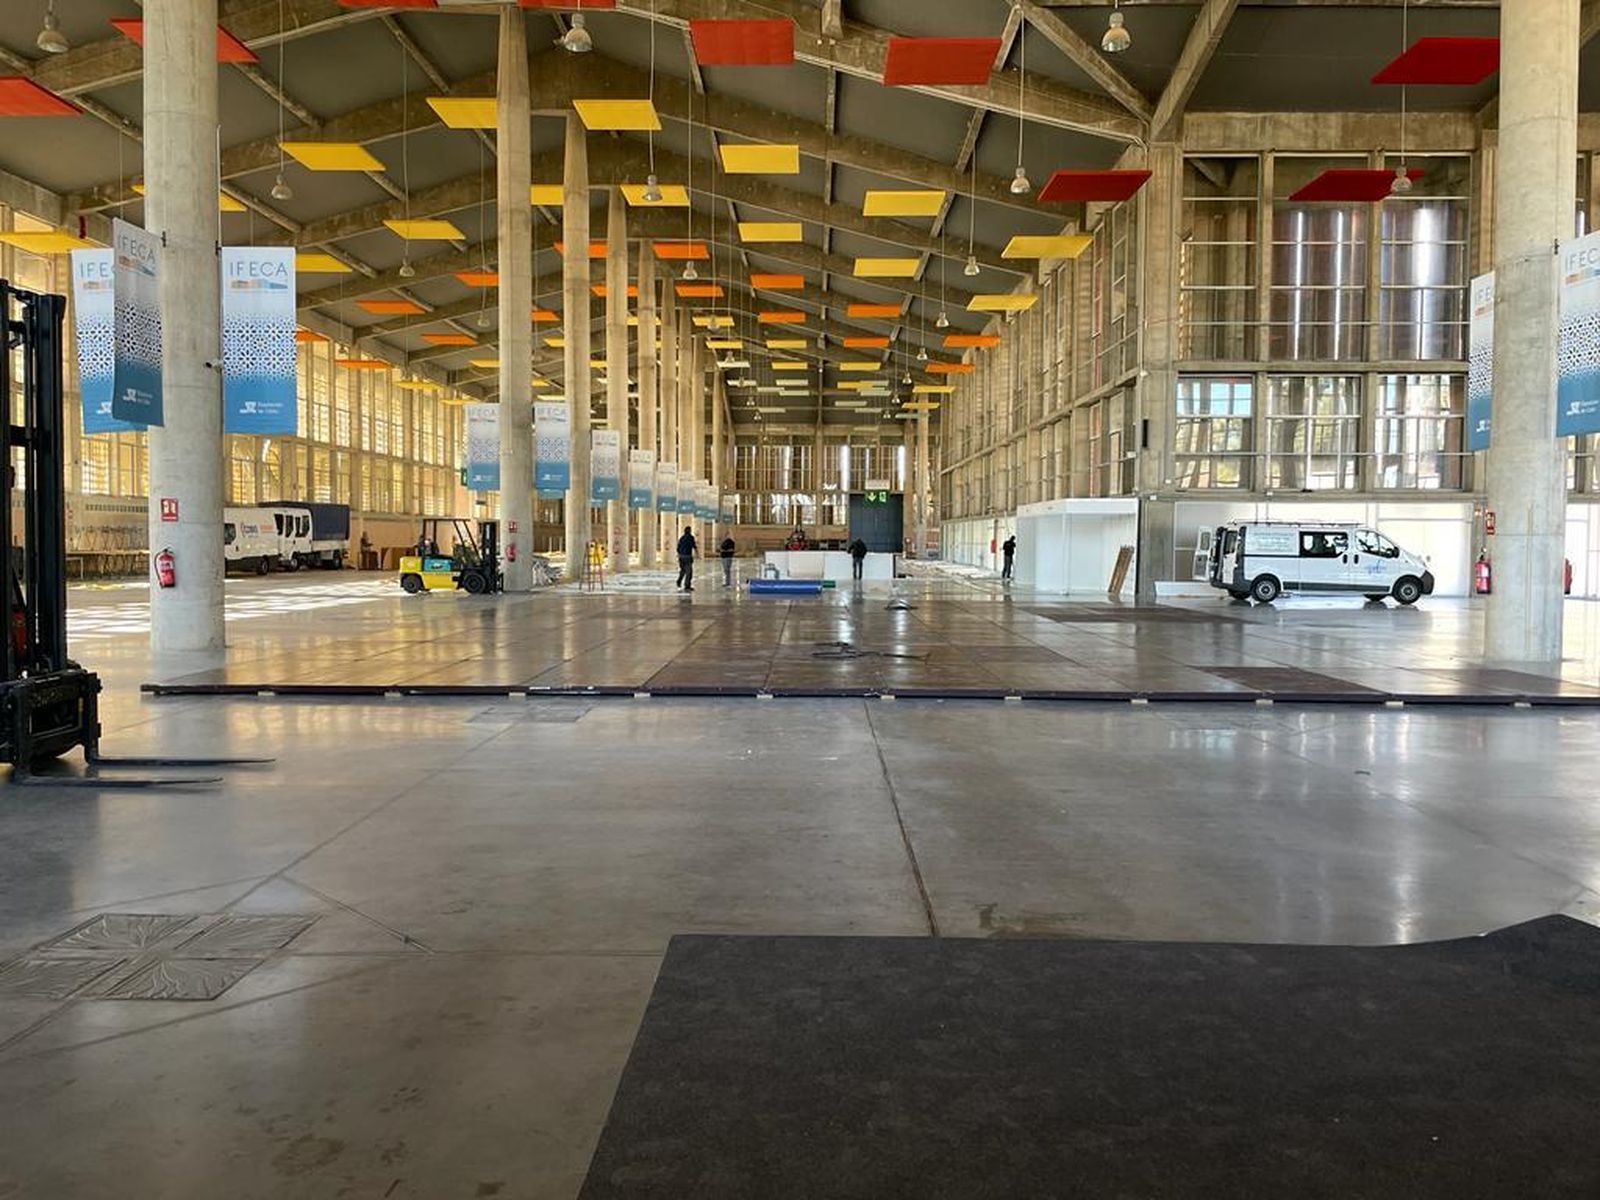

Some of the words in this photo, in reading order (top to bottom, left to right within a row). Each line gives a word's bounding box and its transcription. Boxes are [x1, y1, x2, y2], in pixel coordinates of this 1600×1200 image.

[118, 235, 156, 263] IFECA
[80, 262, 114, 277] IFE
[229, 261, 288, 276] IFECA
